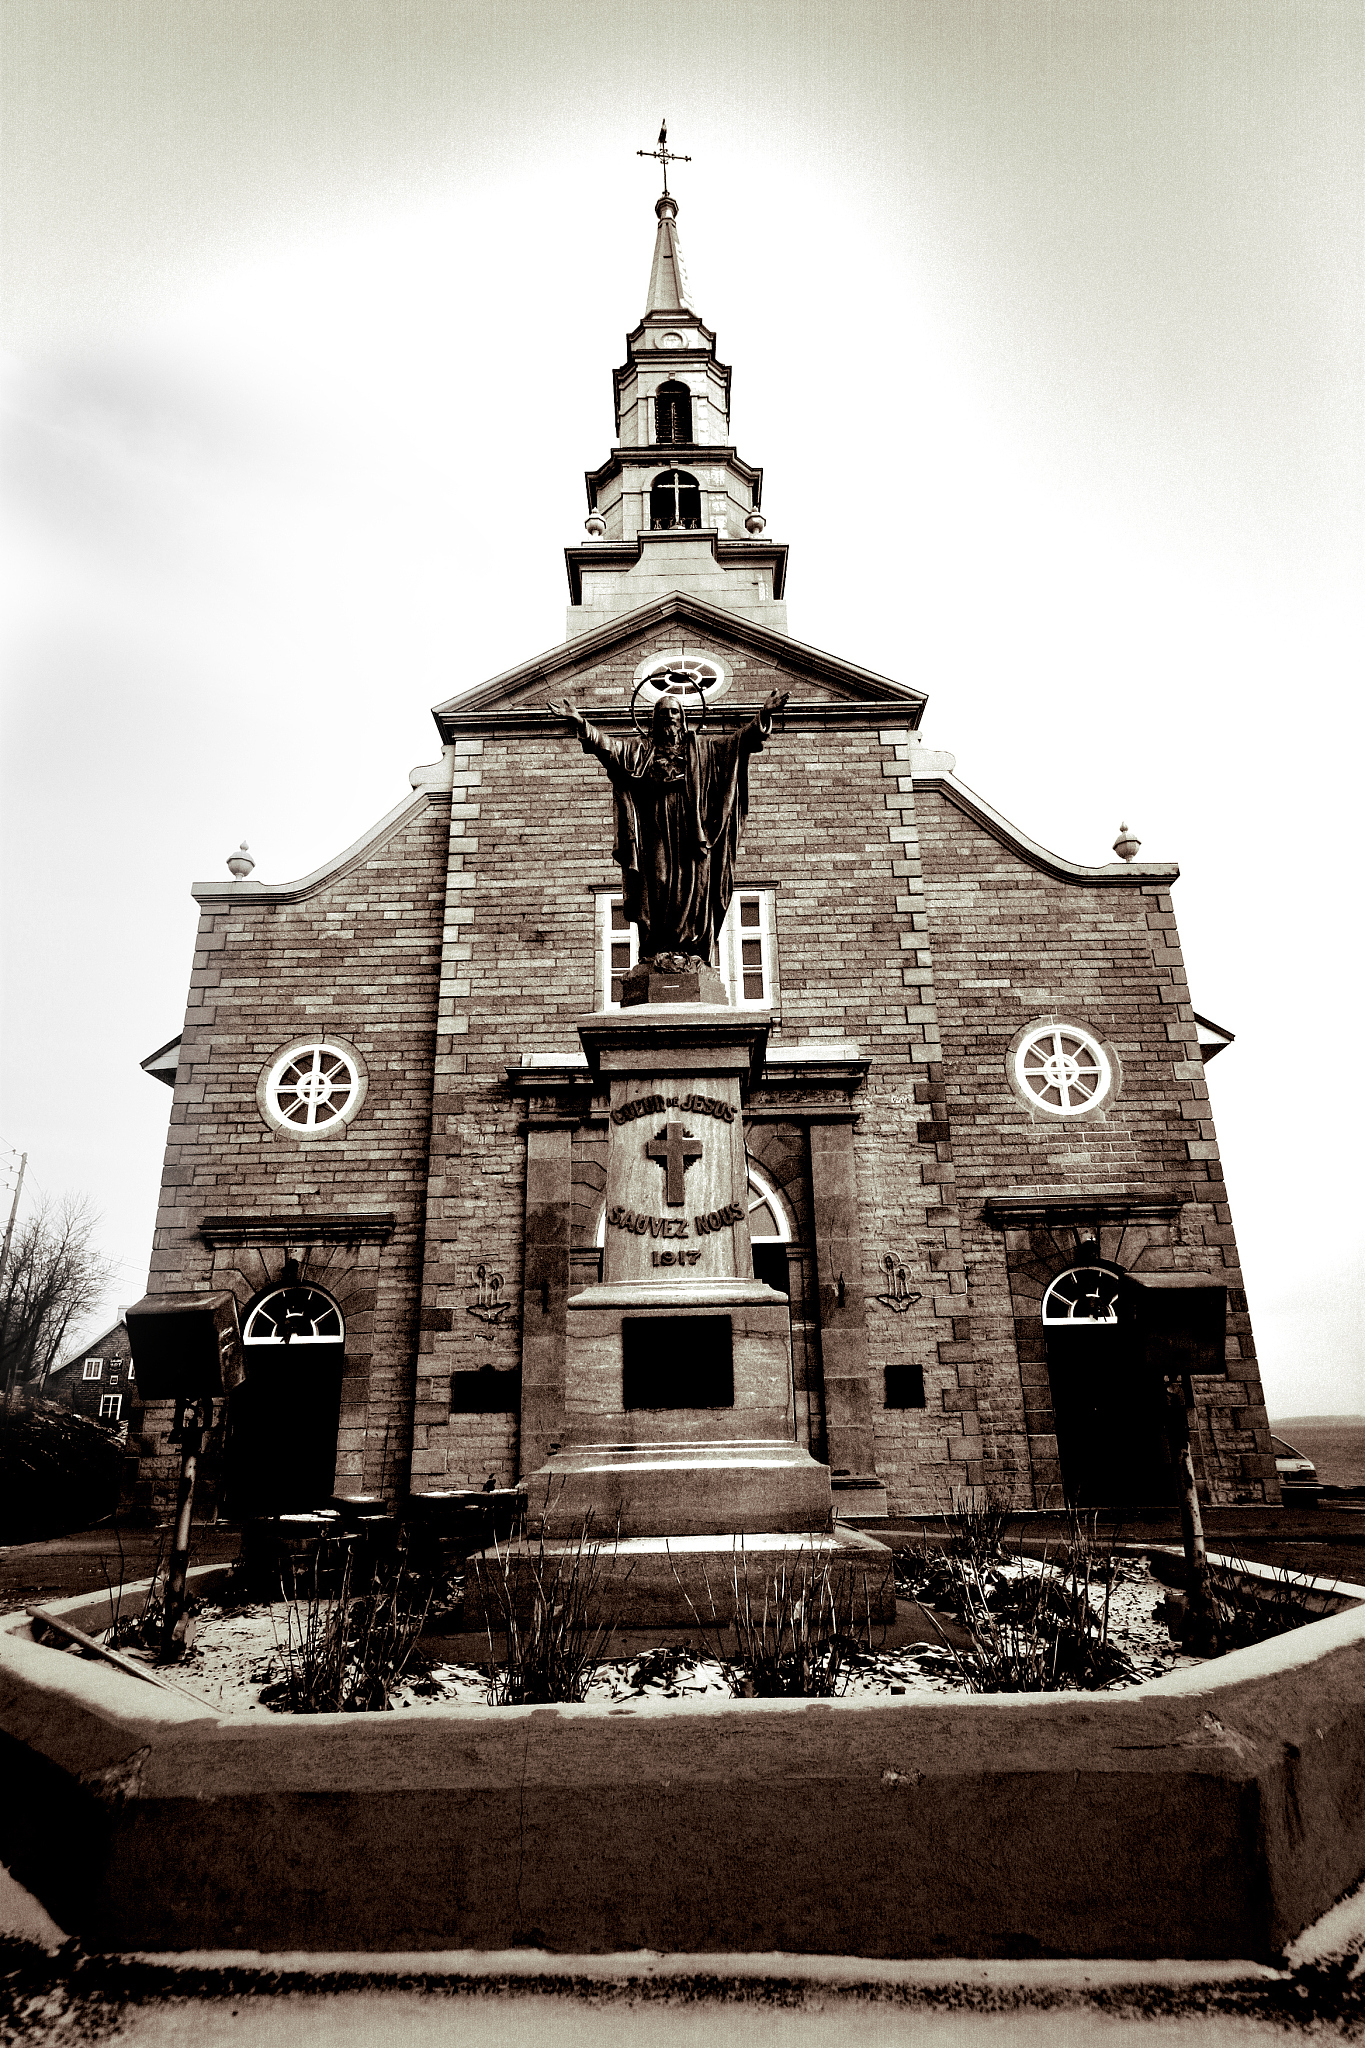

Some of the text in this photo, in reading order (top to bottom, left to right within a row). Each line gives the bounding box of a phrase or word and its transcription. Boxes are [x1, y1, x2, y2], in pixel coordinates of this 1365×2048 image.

[666, 1097, 679, 1107] DE
[680, 1094, 738, 1124] JESUS
[607, 1202, 745, 1238] SAUVEZ NOUS
[652, 1250, 701, 1267] 1917
